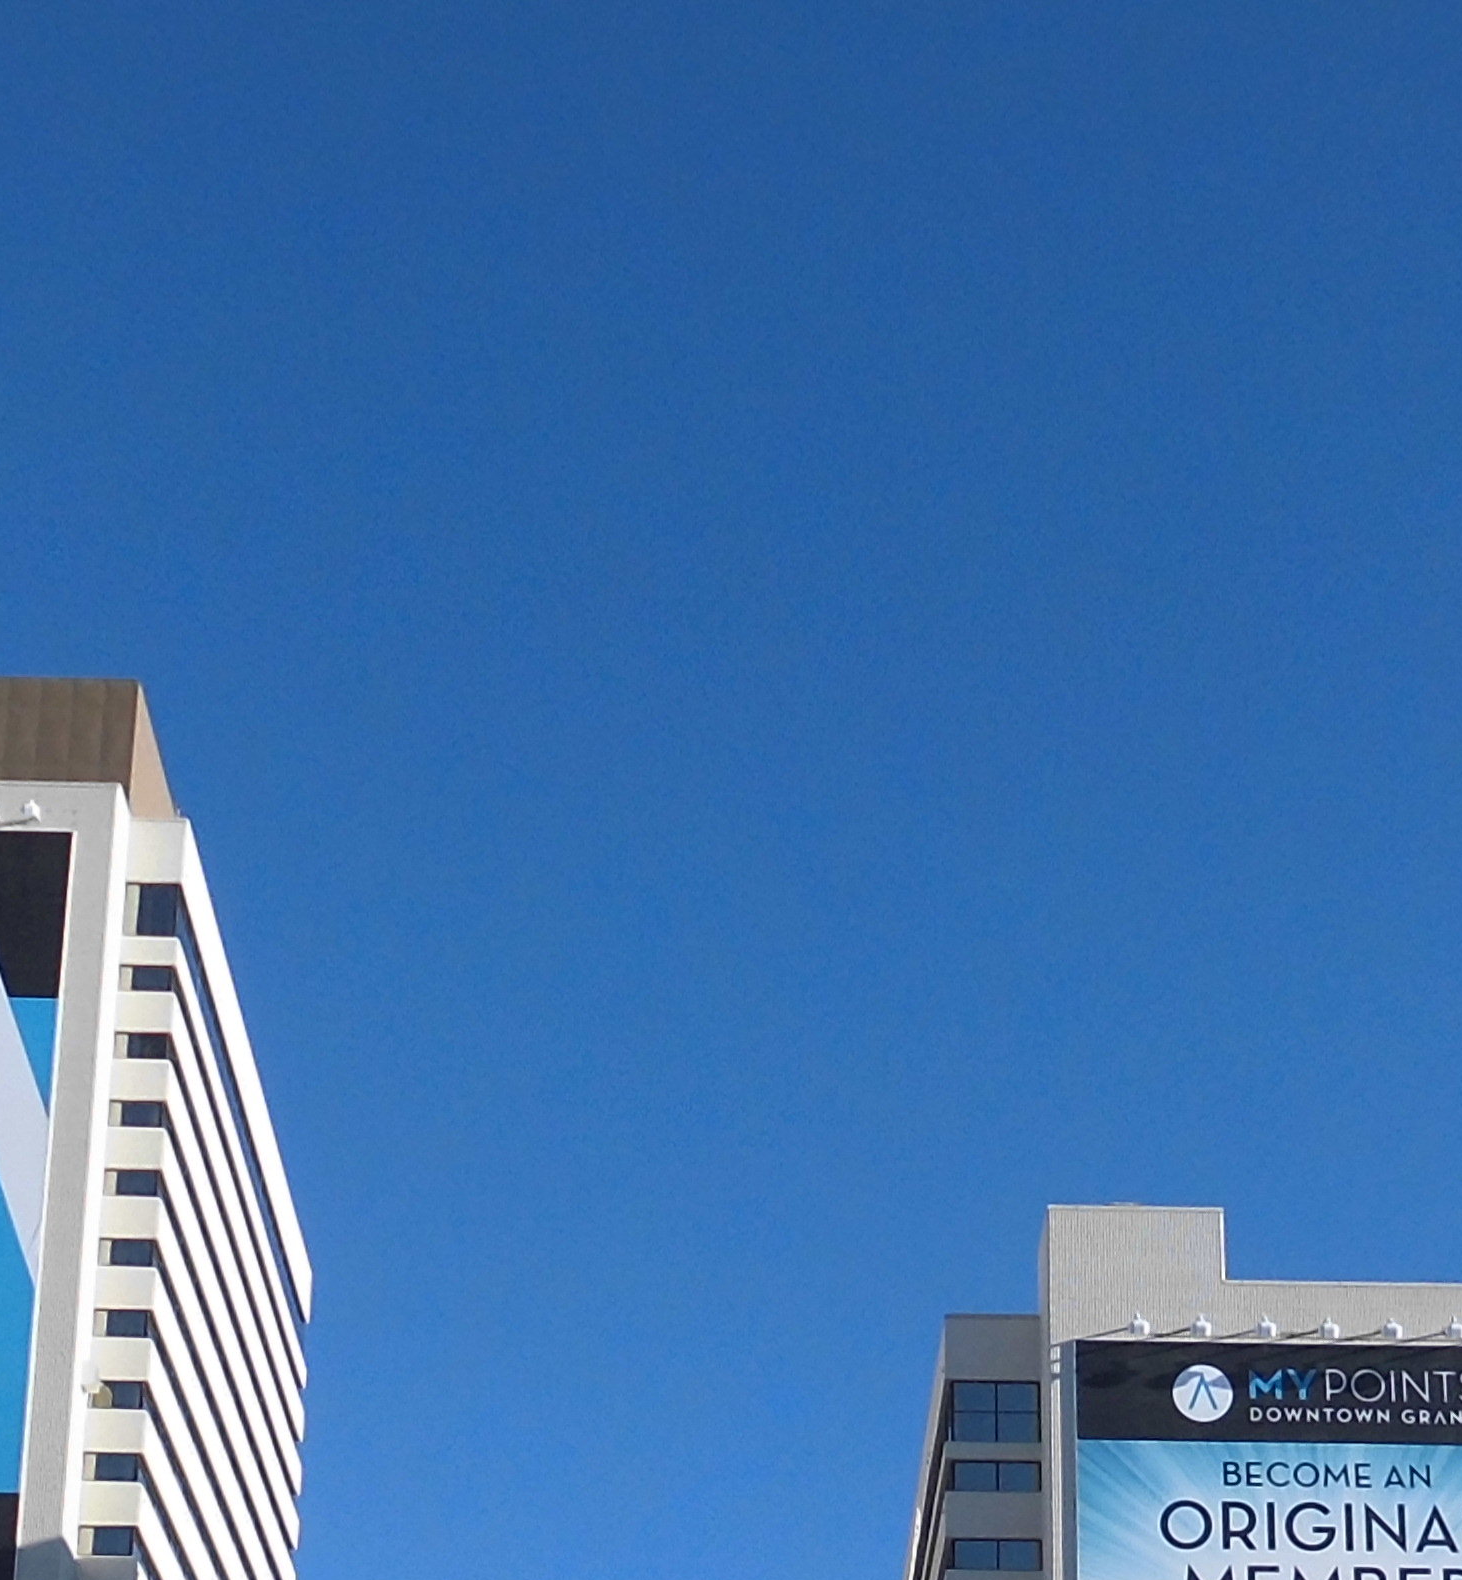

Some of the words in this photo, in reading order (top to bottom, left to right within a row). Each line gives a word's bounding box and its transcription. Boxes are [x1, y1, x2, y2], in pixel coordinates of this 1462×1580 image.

[1249, 1407, 1390, 1423] DOWNTOWN
[1223, 1461, 1372, 1489] BECOME
[1384, 1464, 1432, 1488] AN
